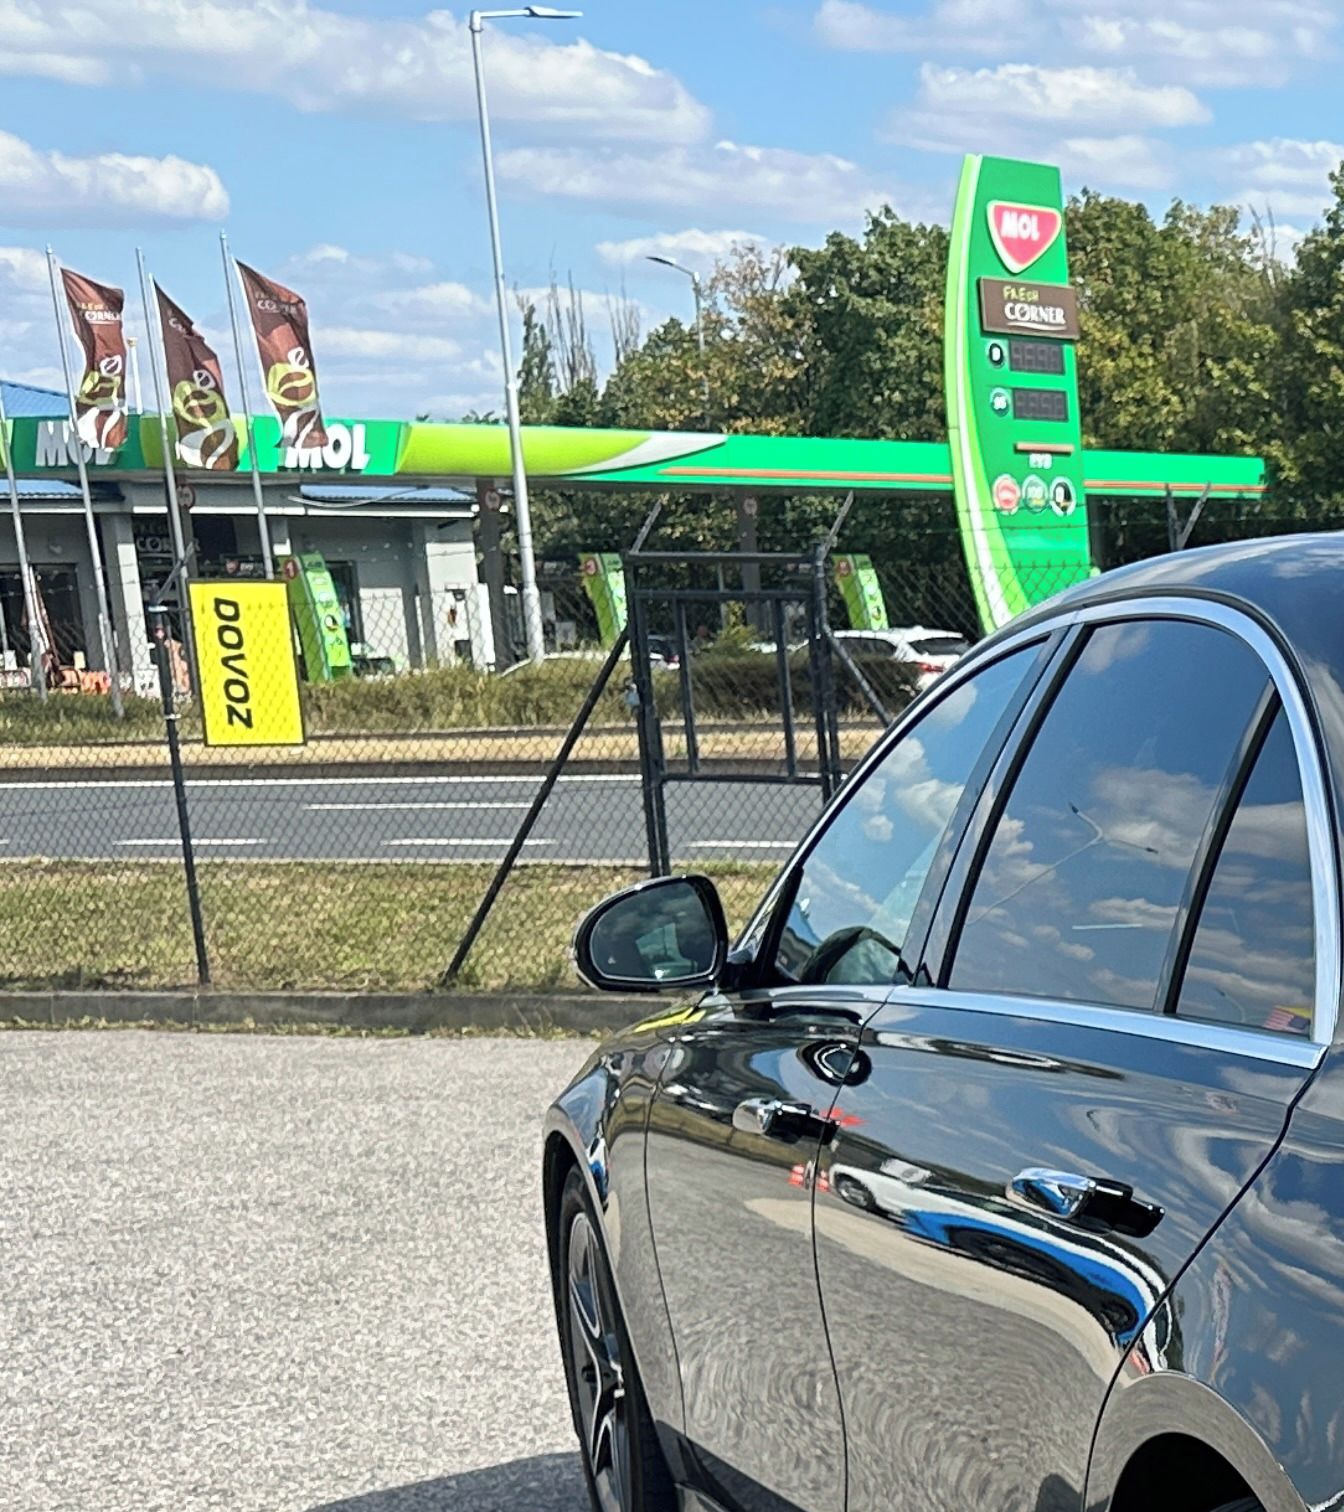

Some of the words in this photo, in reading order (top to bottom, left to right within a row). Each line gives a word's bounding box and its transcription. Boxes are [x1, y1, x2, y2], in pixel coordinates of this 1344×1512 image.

[1000, 210, 1040, 241] MOL
[1004, 302, 1066, 324] CORNER
[214, 597, 253, 729] DOVOZ
